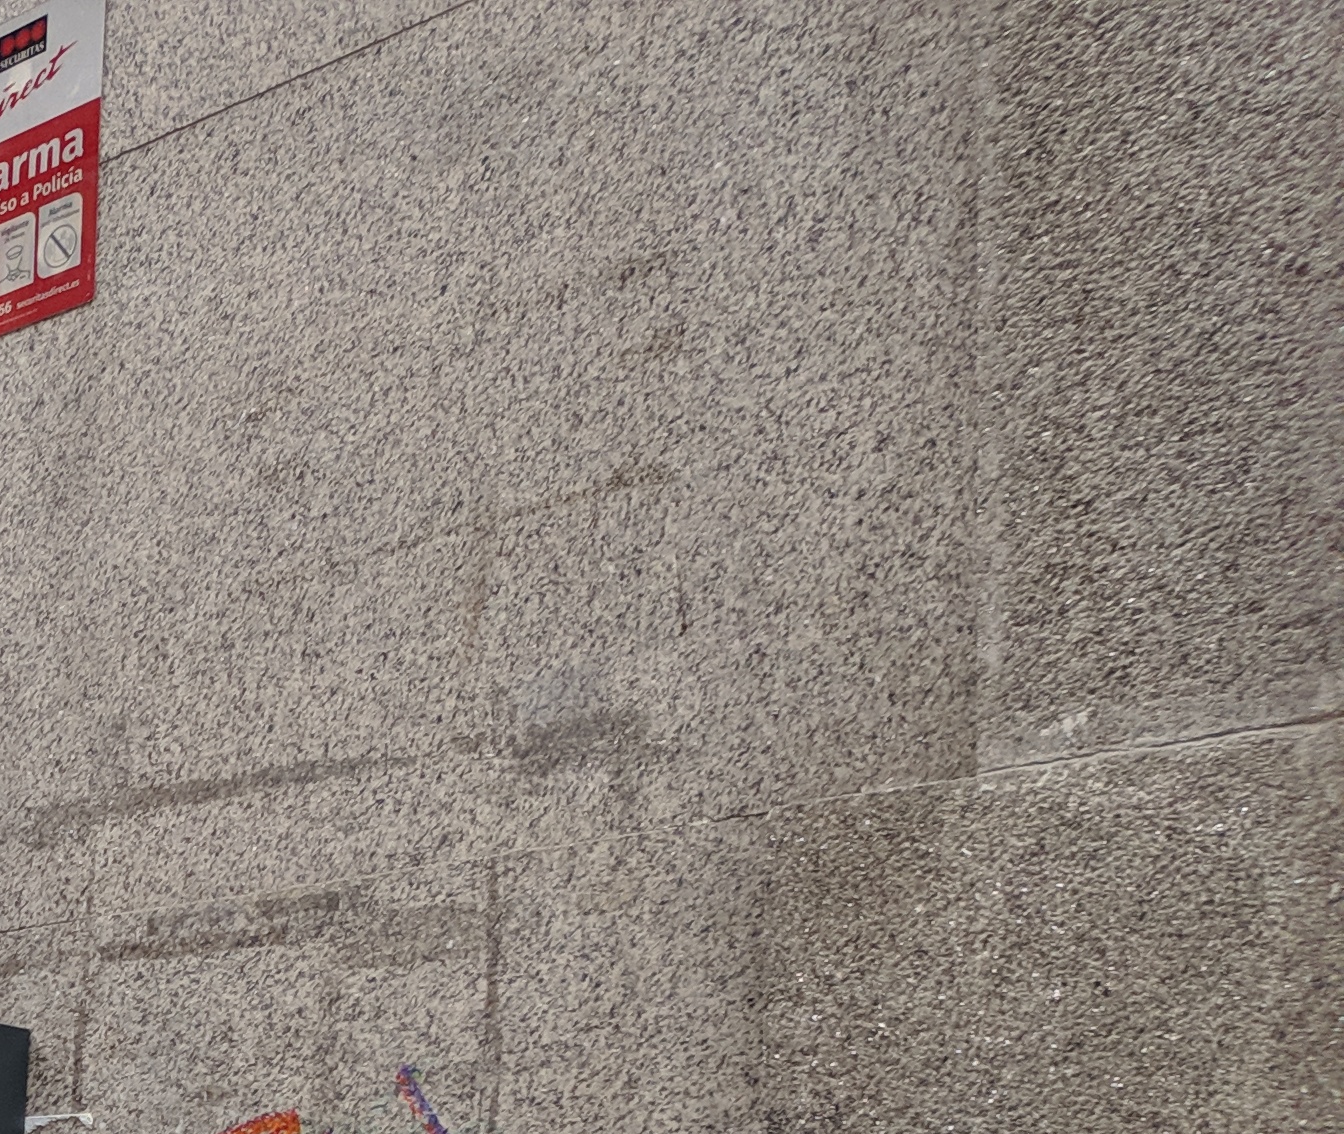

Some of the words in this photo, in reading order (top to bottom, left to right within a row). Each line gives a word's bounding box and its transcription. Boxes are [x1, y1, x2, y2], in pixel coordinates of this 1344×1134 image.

[0, 41, 45, 69] SECURITAS
[20, 192, 30, 206] a
[33, 166, 83, 201] Policía
